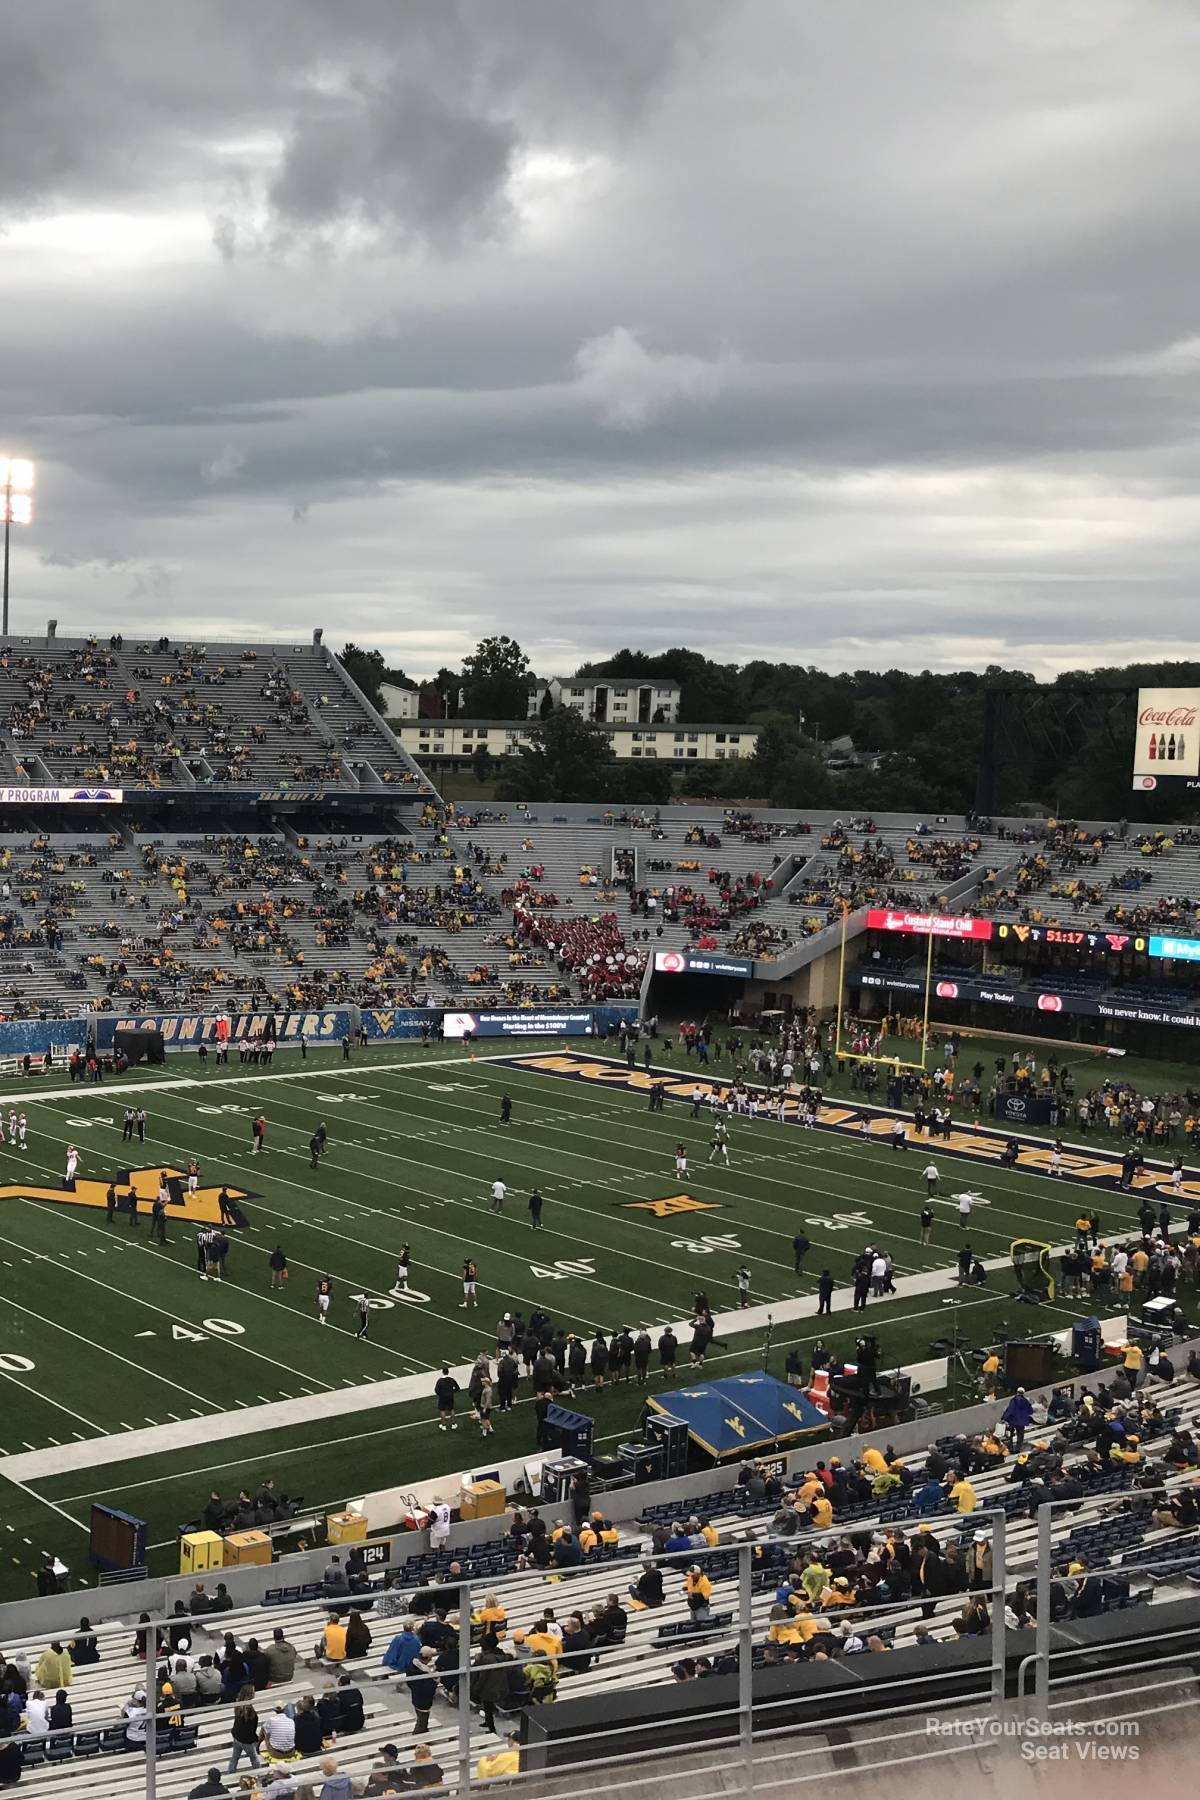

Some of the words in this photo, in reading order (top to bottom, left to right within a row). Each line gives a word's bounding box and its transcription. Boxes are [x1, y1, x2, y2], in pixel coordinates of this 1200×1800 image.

[8, 788, 60, 801] PROGRAM
[933, 916, 954, 929] Stand
[956, 919, 972, 931] Chili
[999, 925, 1008, 938] 0
[1046, 930, 1084, 944] 51:17
[1135, 938, 1145, 951] 0
[980, 991, 994, 1001] Play
[994, 993, 1014, 1003] Today!
[1098, 1005, 1114, 1016] You
[1115, 1009, 1137, 1018] never
[1138, 1010, 1162, 1021] know.
[1163, 1013, 1170, 1022] It
[1171, 1015, 1194, 1026] could
[502, 1022, 527, 1030] Starting
[316, 1093, 368, 1102] 20
[195, 1104, 250, 1114] 30
[1004, 1110, 1027, 1118] TOYOTA
[65, 1116, 114, 1127] 40
[804, 1212, 874, 1231] 20
[670, 1234, 743, 1254] 30
[528, 1259, 596, 1280] 40
[171, 1318, 246, 1342] 40
[362, 1546, 384, 1563] 124
